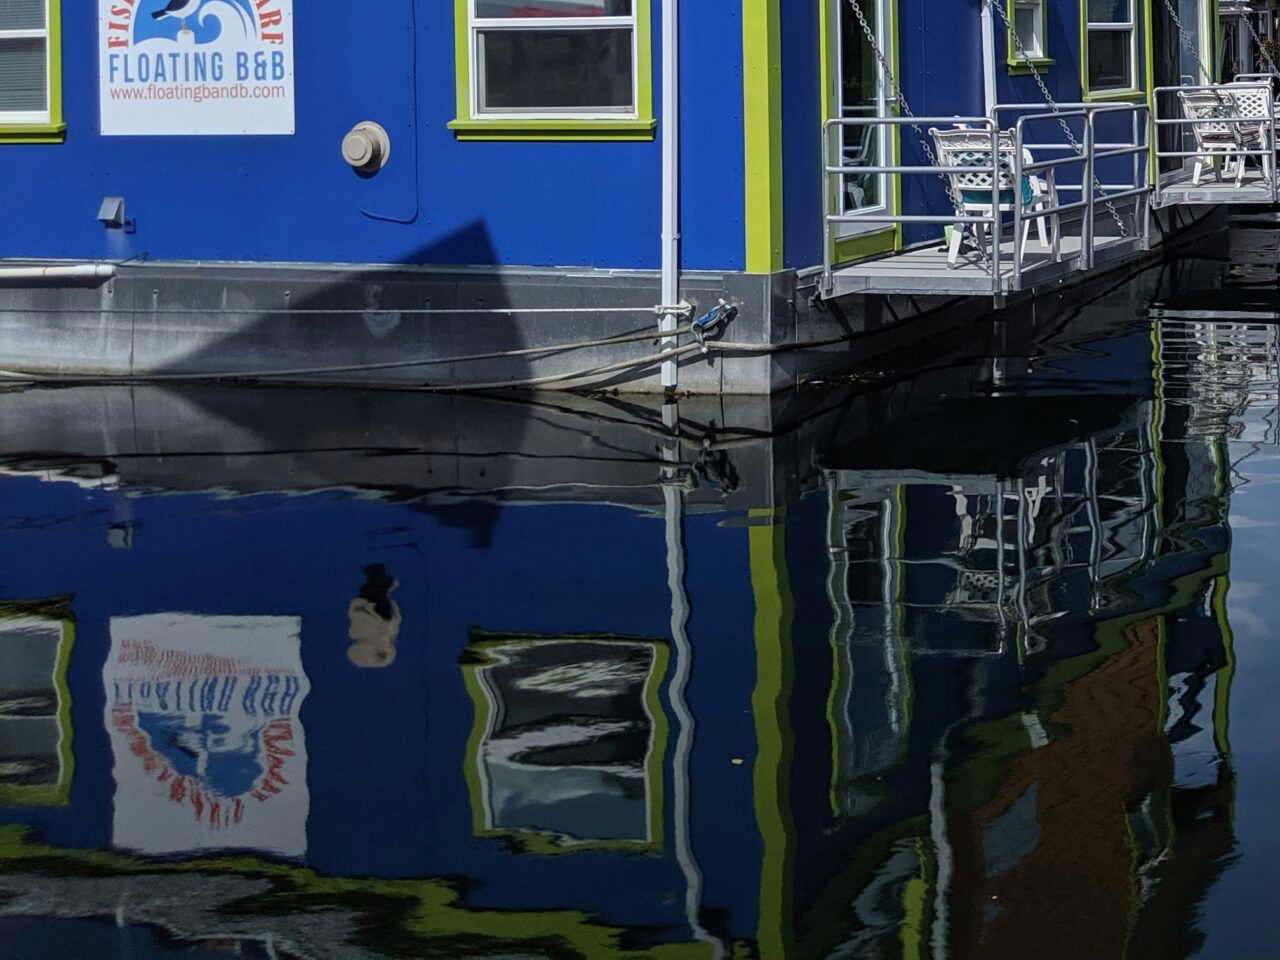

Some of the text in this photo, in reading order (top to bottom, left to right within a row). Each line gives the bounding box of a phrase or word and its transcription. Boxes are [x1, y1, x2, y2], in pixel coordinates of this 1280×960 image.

[108, 50, 286, 84] FLOATING B&B
[110, 83, 286, 103] www.floatingbandb.com
